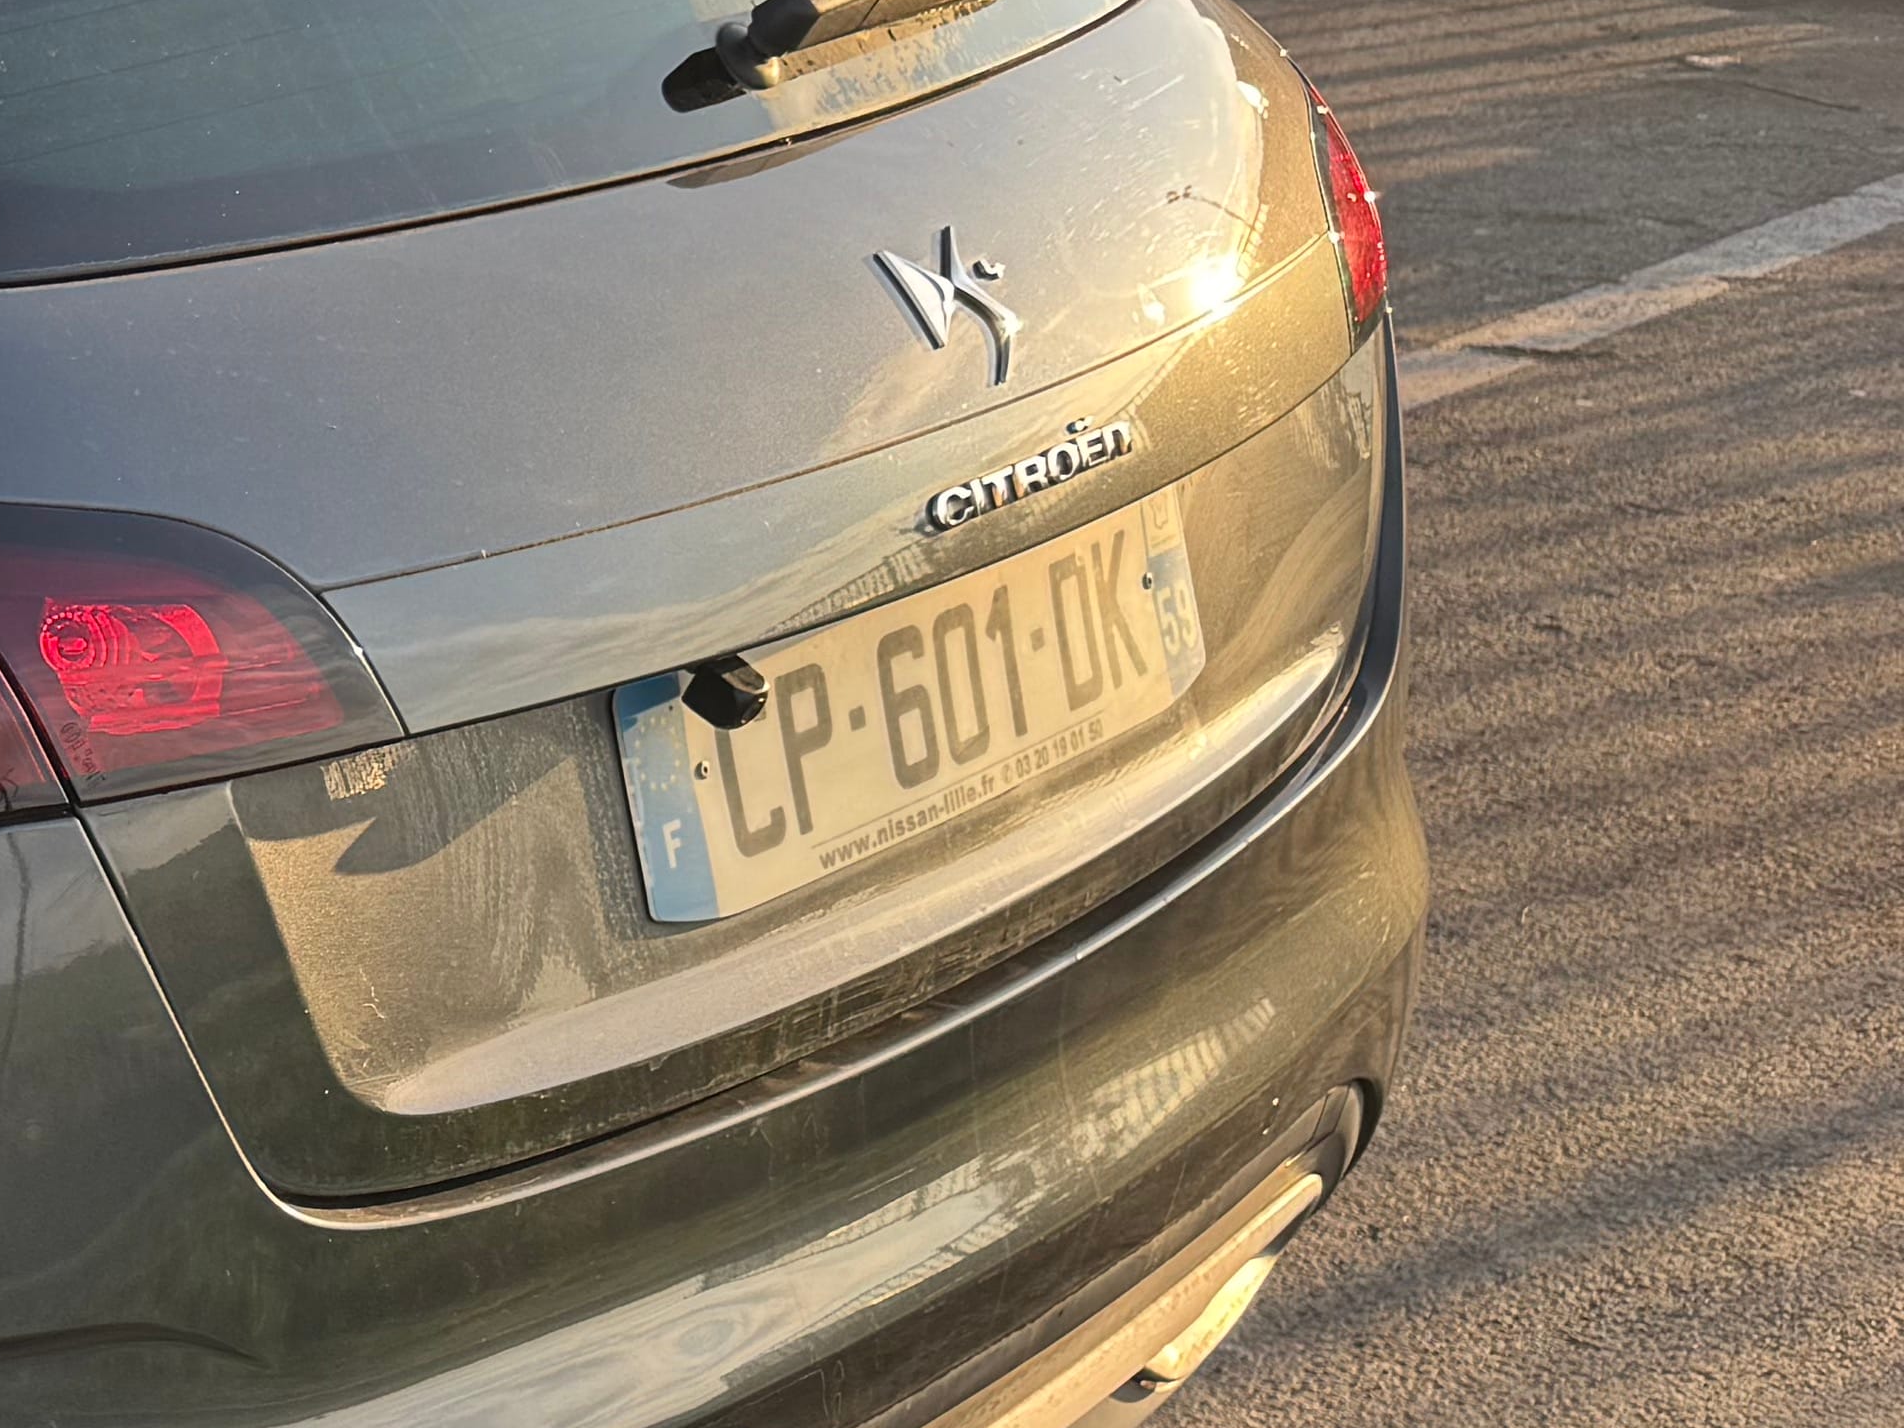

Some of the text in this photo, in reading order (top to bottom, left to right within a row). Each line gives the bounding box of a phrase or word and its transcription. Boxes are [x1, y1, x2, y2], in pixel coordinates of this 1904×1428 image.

[927, 416, 1133, 531] CITROËN
[1157, 579, 1198, 657] 59
[662, 819, 682, 869] F
[818, 774, 995, 870] www.nissan-lille.fr
[1034, 747, 1050, 769] 20
